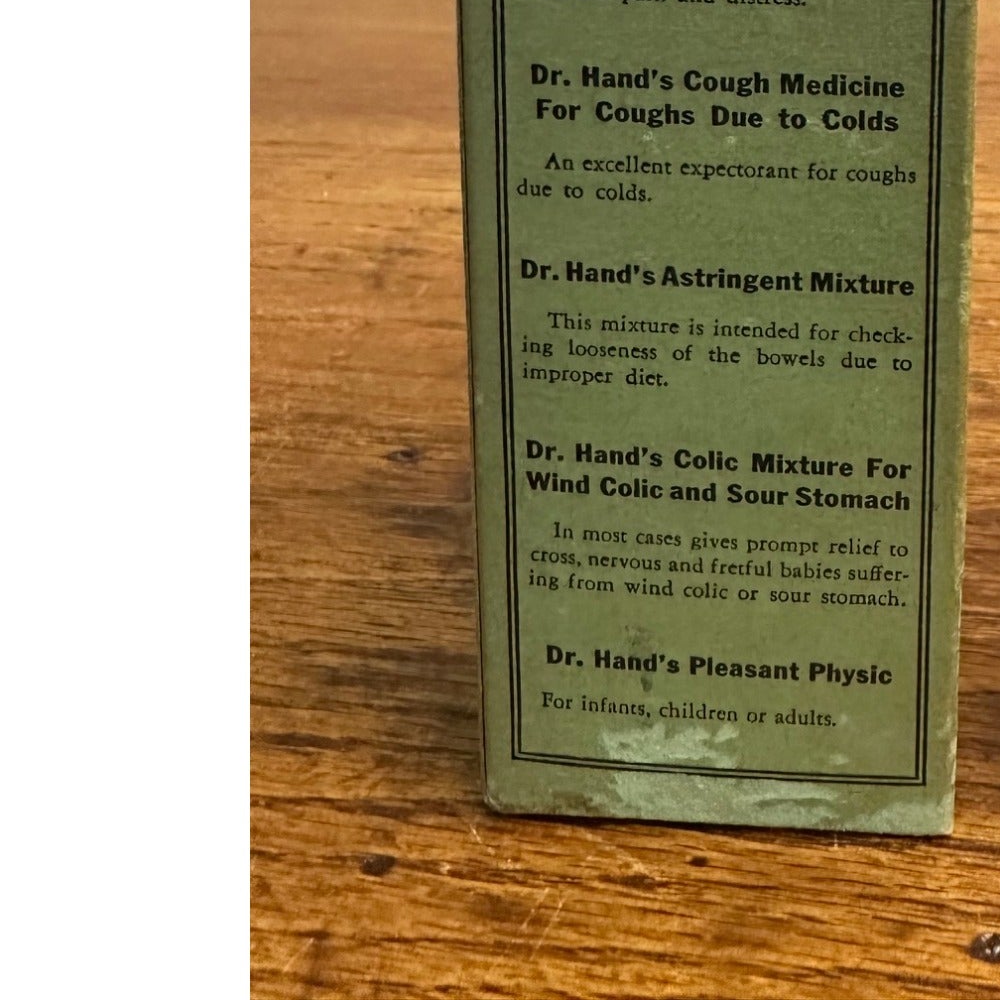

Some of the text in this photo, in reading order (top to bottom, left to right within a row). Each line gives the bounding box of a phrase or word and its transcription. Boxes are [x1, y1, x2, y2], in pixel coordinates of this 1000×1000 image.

[530, 63, 905, 99] Dr. Hand's Cough Medicine
[535, 97, 900, 133] For Coughs Due to Colds
[544, 151, 917, 187] An excellent expectorant for coughs
[516, 177, 653, 203] due to colds.
[520, 258, 915, 297] Dr. Hand's Astringent Mixture
[546, 311, 914, 344] This mixture is intended for check-
[521, 334, 913, 372] ing looseness of the bowels due to
[522, 361, 669, 388] improper diet.
[525, 439, 913, 480] Dr. Hand's Colic Mixture For
[525, 470, 911, 511] Wind Colic and Sour Stomach
[553, 521, 909, 558] In most cases gives prompt relief to
[530, 549, 910, 582] cross, nervous and fretful babies suffer-
[528, 568, 907, 608] ing from wind colic or sour stomach.
[545, 644, 893, 687] Dr. Hand's Pleasant Physic
[541, 691, 837, 728] For infants, children or adults.
